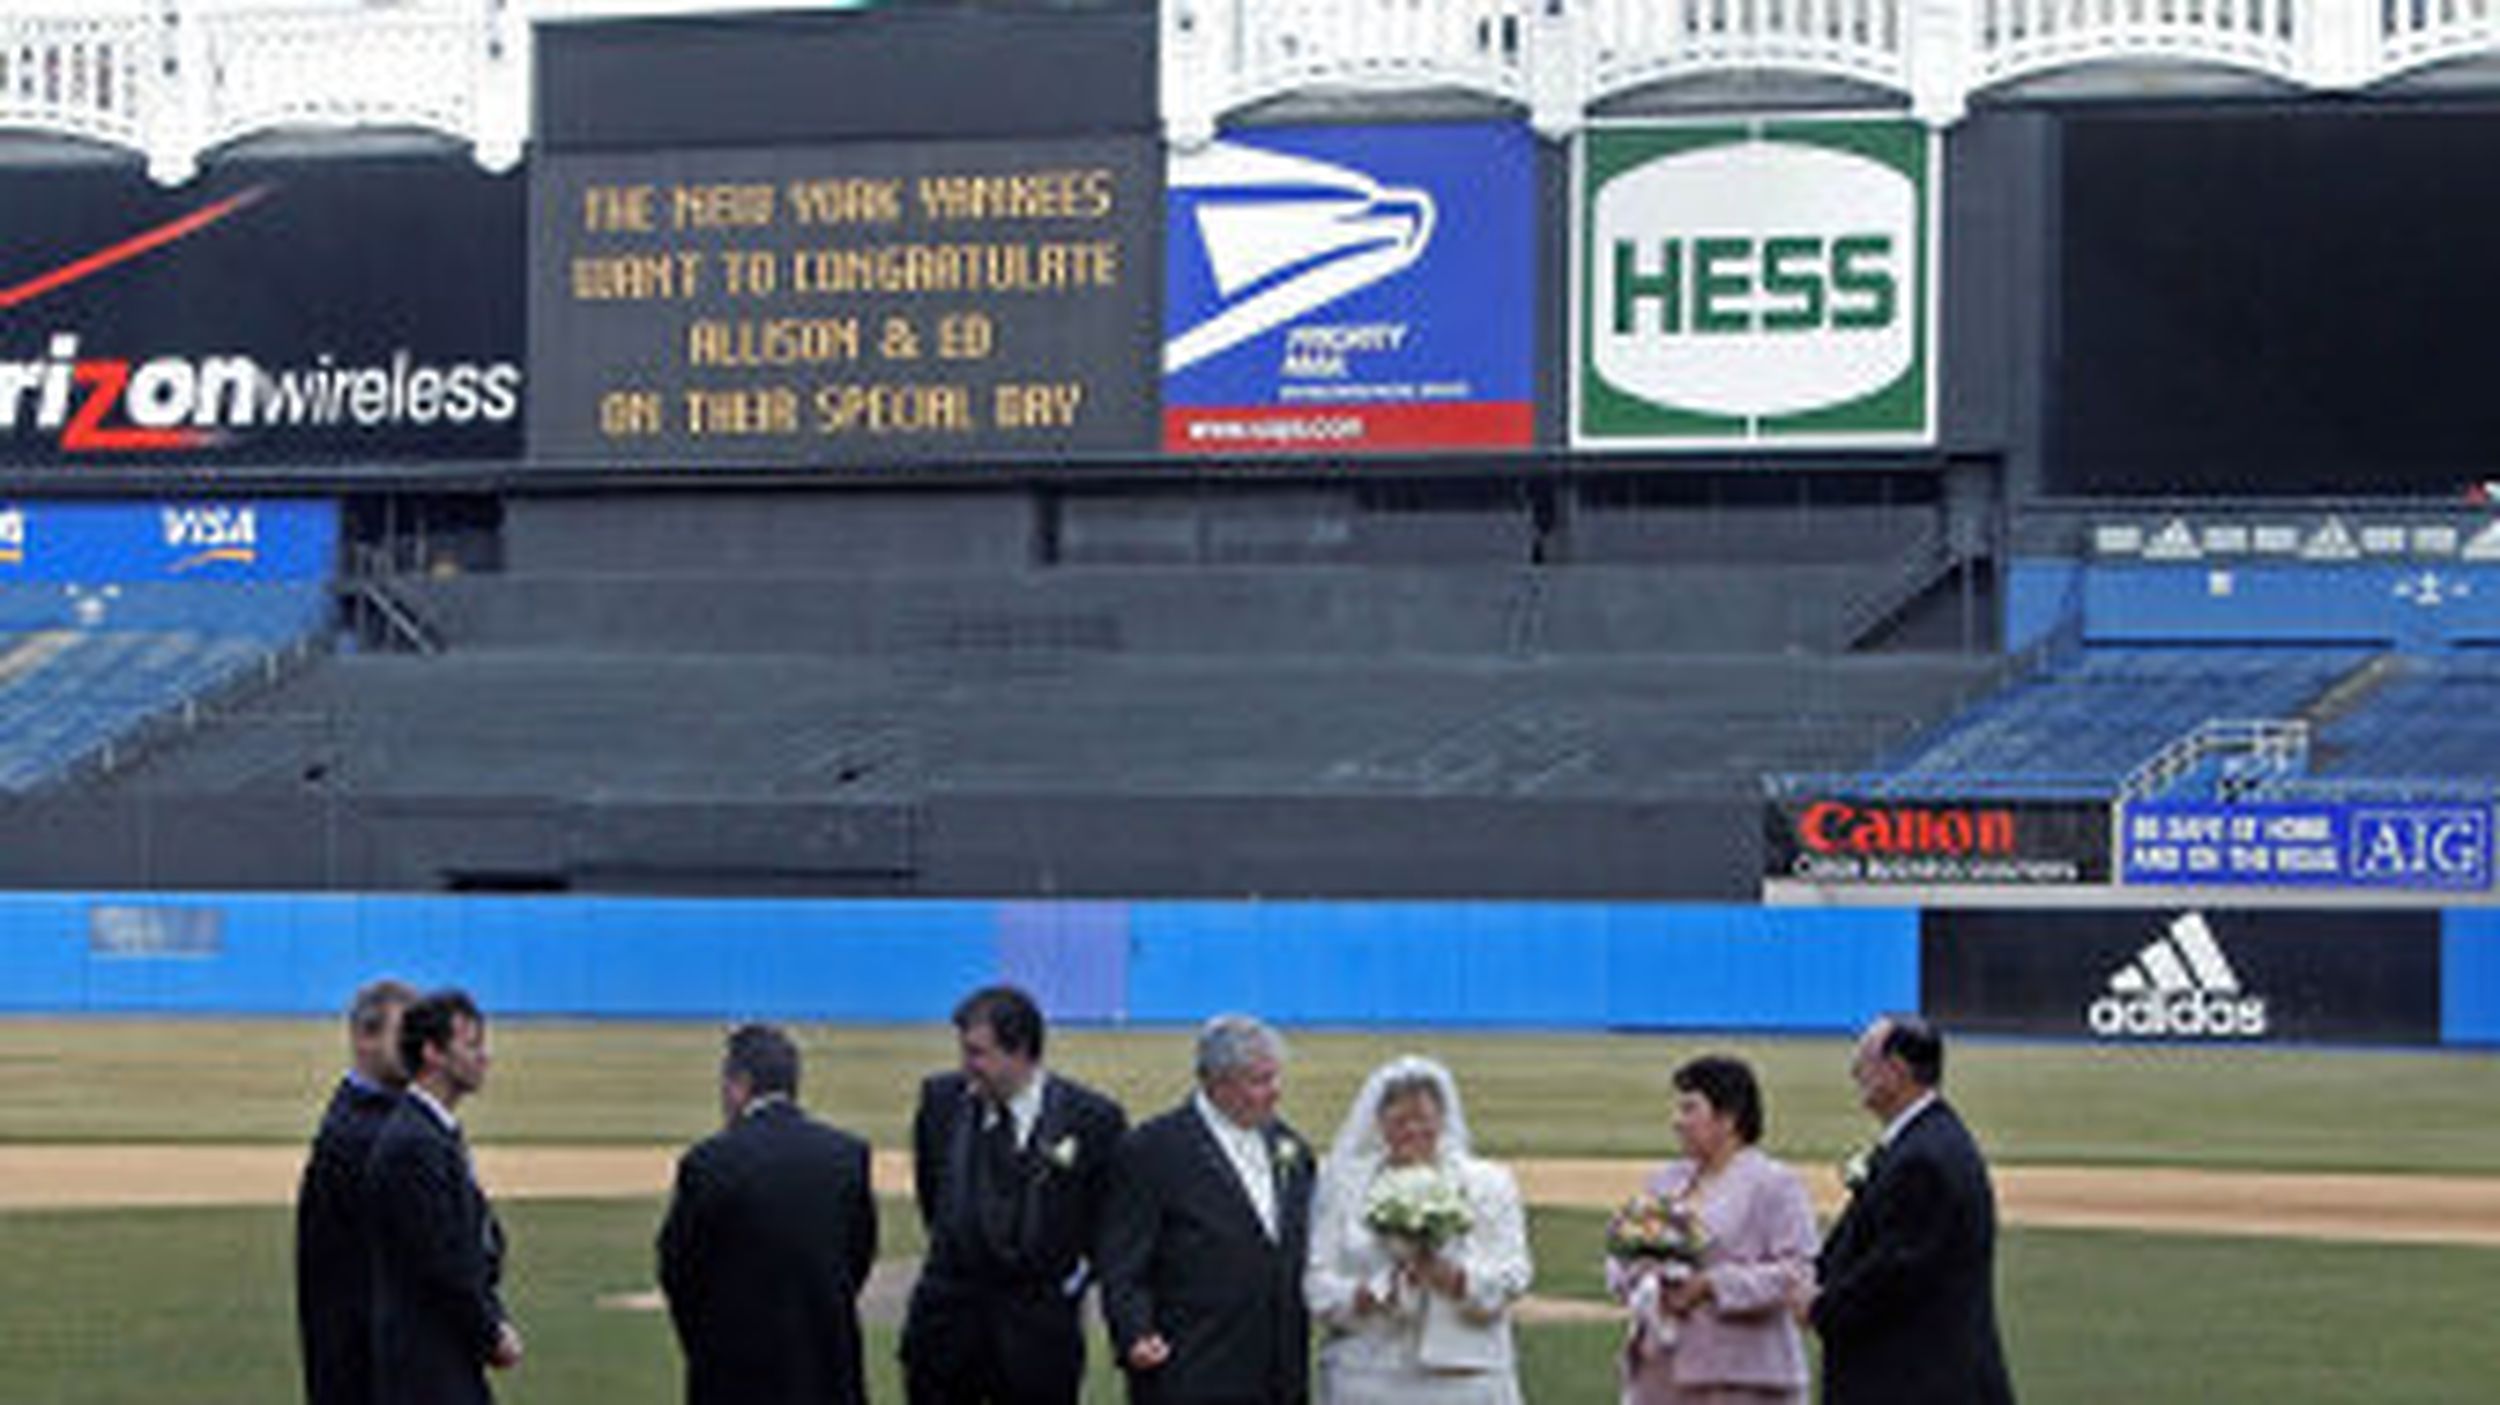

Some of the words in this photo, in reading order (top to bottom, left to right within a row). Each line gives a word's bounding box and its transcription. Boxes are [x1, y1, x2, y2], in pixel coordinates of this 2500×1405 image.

[586, 184, 653, 232] THE
[673, 182, 775, 230] NEW
[790, 177, 901, 226] YORK
[919, 168, 1113, 220] YANKEES
[572, 250, 702, 298] WANT
[722, 250, 776, 295] TO
[793, 243, 1119, 294] CONGRATULATE
[1613, 236, 1897, 334] HESS
[690, 317, 859, 366] ALLISON
[881, 317, 921, 361] &
[937, 313, 993, 360] ED
[264, 350, 521, 426] wireless
[602, 391, 662, 435] ON
[687, 387, 799, 433] THEIR
[815, 383, 971, 432] SPECIAL
[996, 381, 1081, 426] DAY
[163, 508, 256, 544] VISA
[1799, 802, 2015, 853] Canon
[2362, 821, 2478, 875] AIG
[2089, 988, 2267, 1036] adidas
